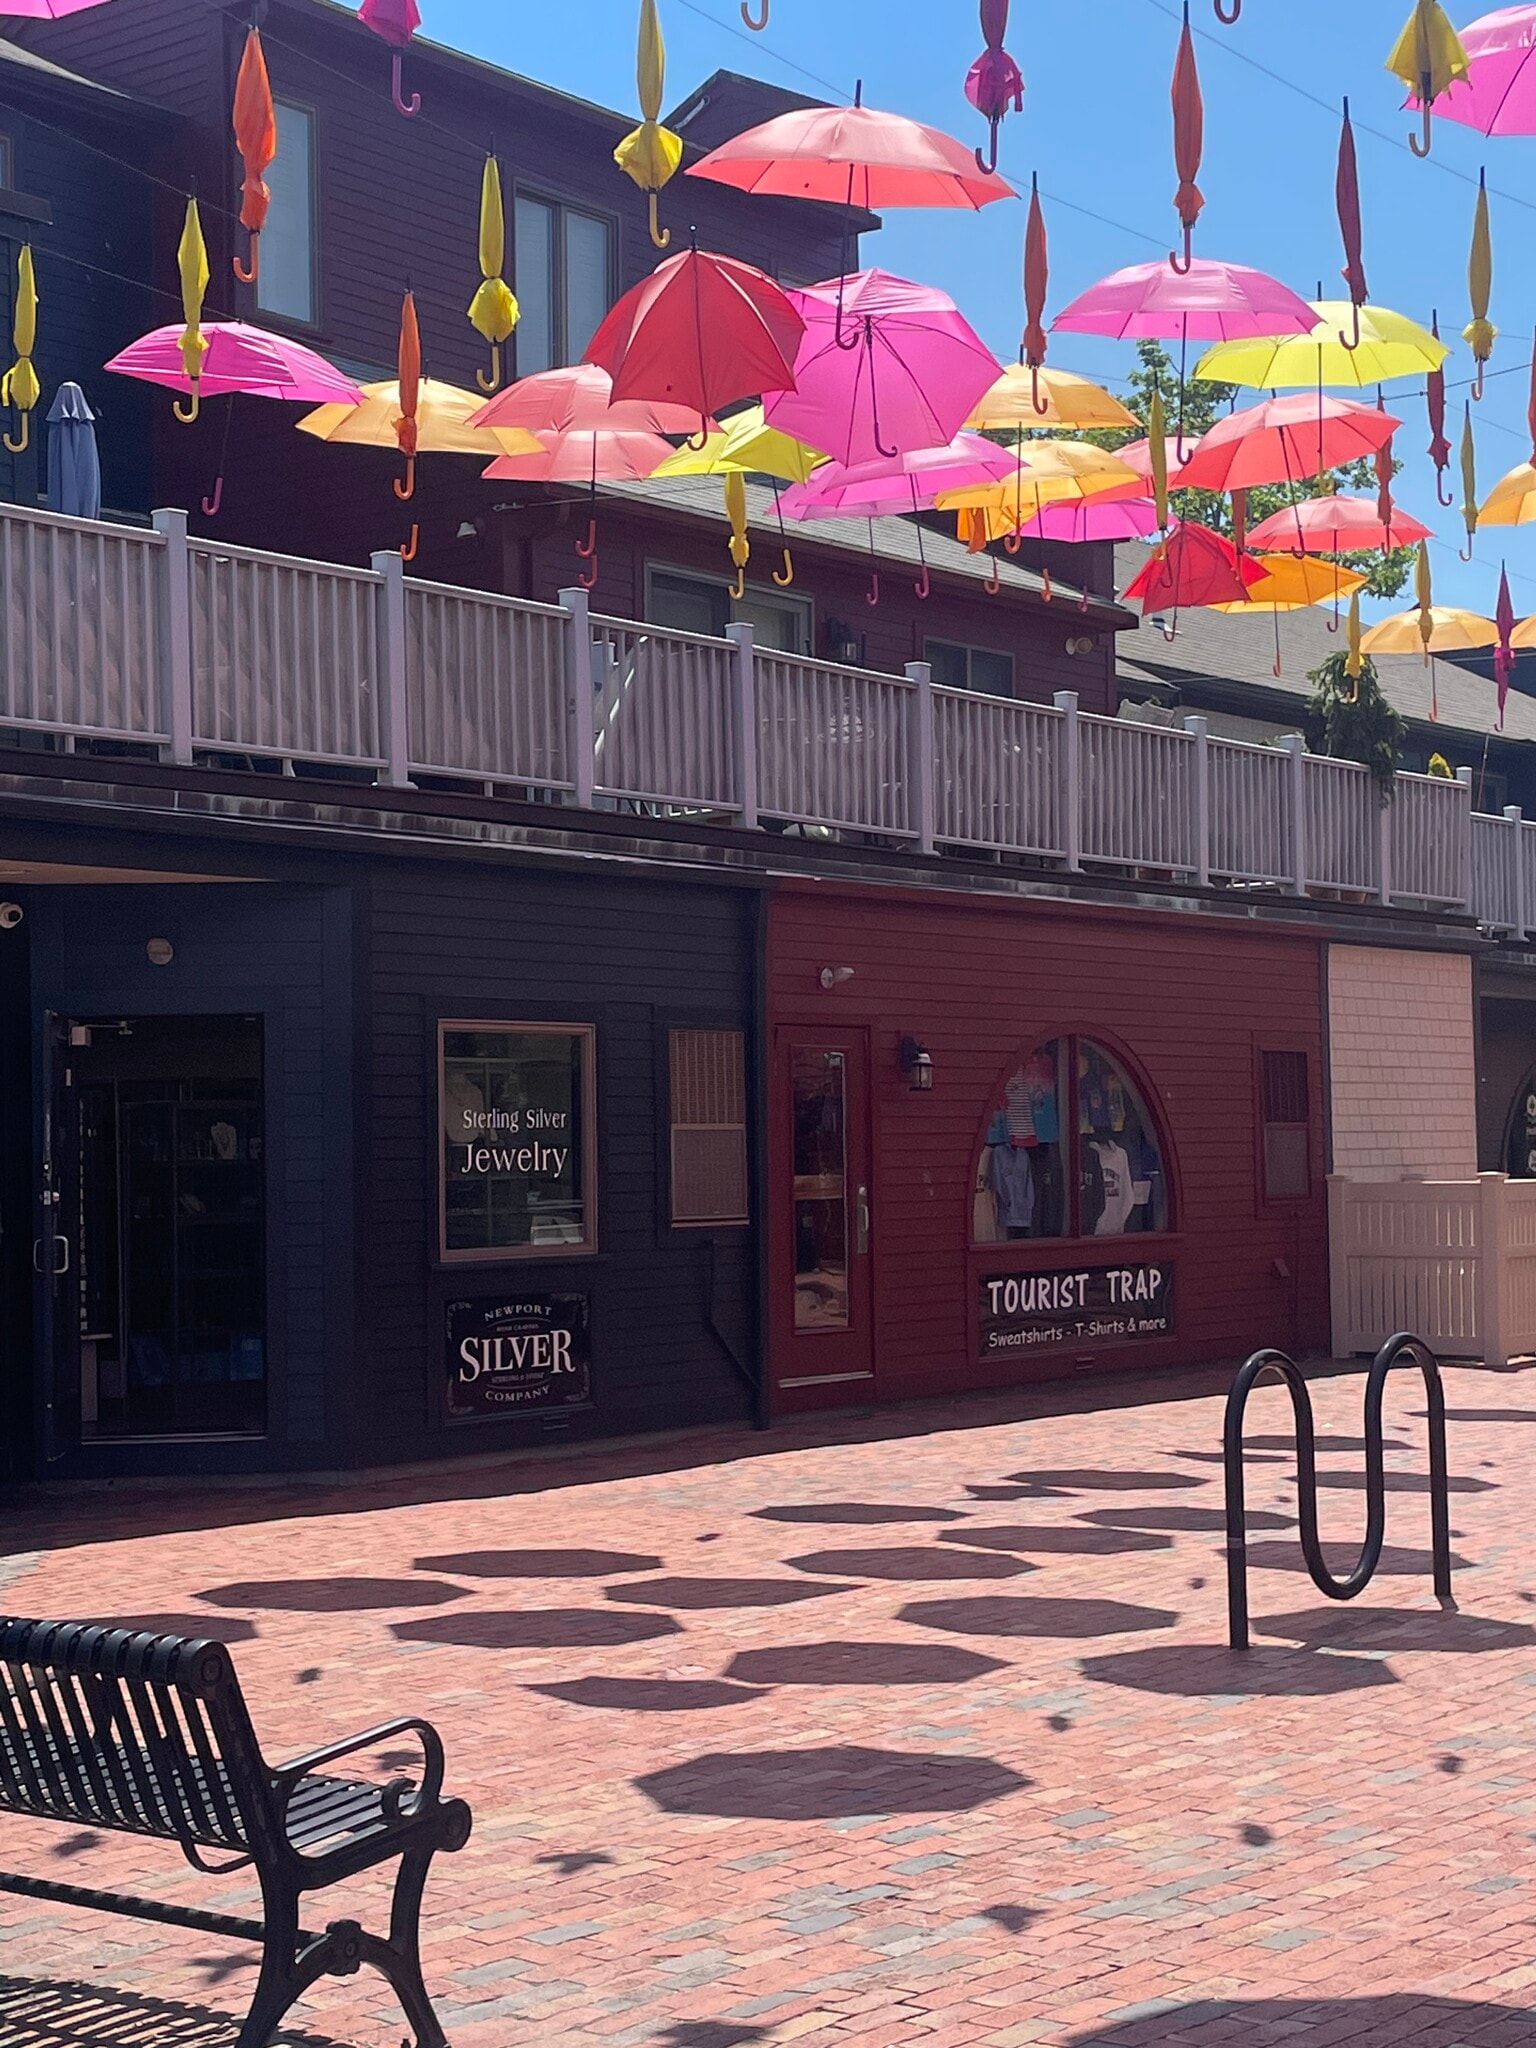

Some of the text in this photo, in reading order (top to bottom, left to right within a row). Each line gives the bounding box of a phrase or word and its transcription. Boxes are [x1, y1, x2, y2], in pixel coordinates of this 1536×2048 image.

[463, 1107, 566, 1133] Sterling Silver
[461, 1141, 568, 1179] Jewelry
[987, 1268, 1161, 1315] TOURIST TRAP
[484, 1304, 552, 1321] NEWPORT
[988, 1327, 1063, 1348] Sweatshirts
[1075, 1319, 1125, 1338] T-Shirts
[1127, 1317, 1136, 1333] &
[1139, 1317, 1167, 1332] more
[459, 1329, 577, 1382] SILVER
[485, 1384, 551, 1401] COMPANY
